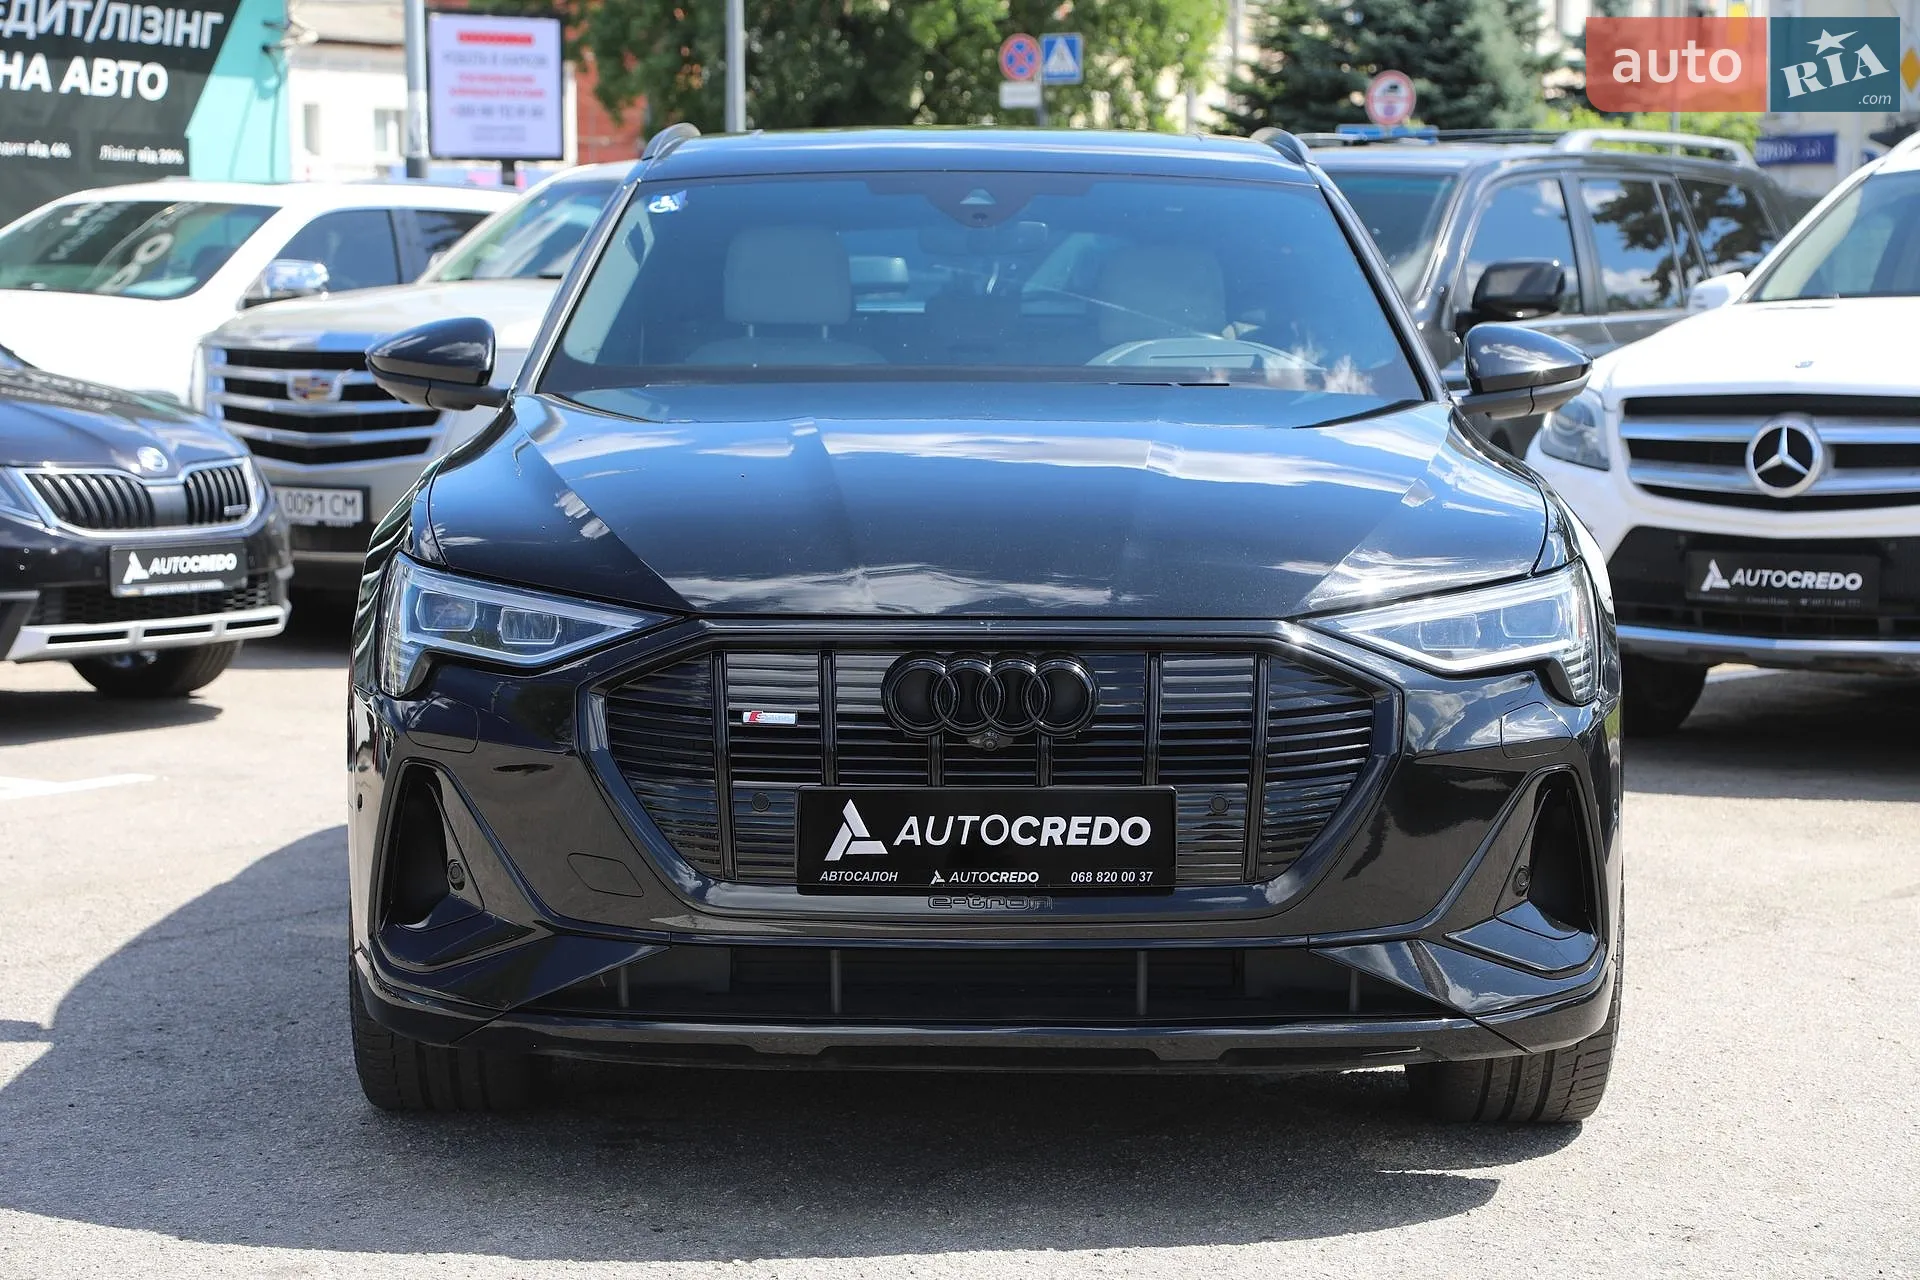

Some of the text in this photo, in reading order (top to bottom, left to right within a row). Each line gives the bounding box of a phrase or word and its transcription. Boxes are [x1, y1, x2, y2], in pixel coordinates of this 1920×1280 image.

[0, 51, 169, 101] НА АВТО
[148, 553, 237, 575] AUTOCREDO
[1731, 568, 1863, 591] AUTOCREDO
[893, 814, 1152, 847] AUTOCREDO
[819, 871, 898, 883] АВТОСАЛОН
[949, 871, 1040, 883] AUTOCREDO
[1070, 871, 1153, 883] 068 820 00 37
